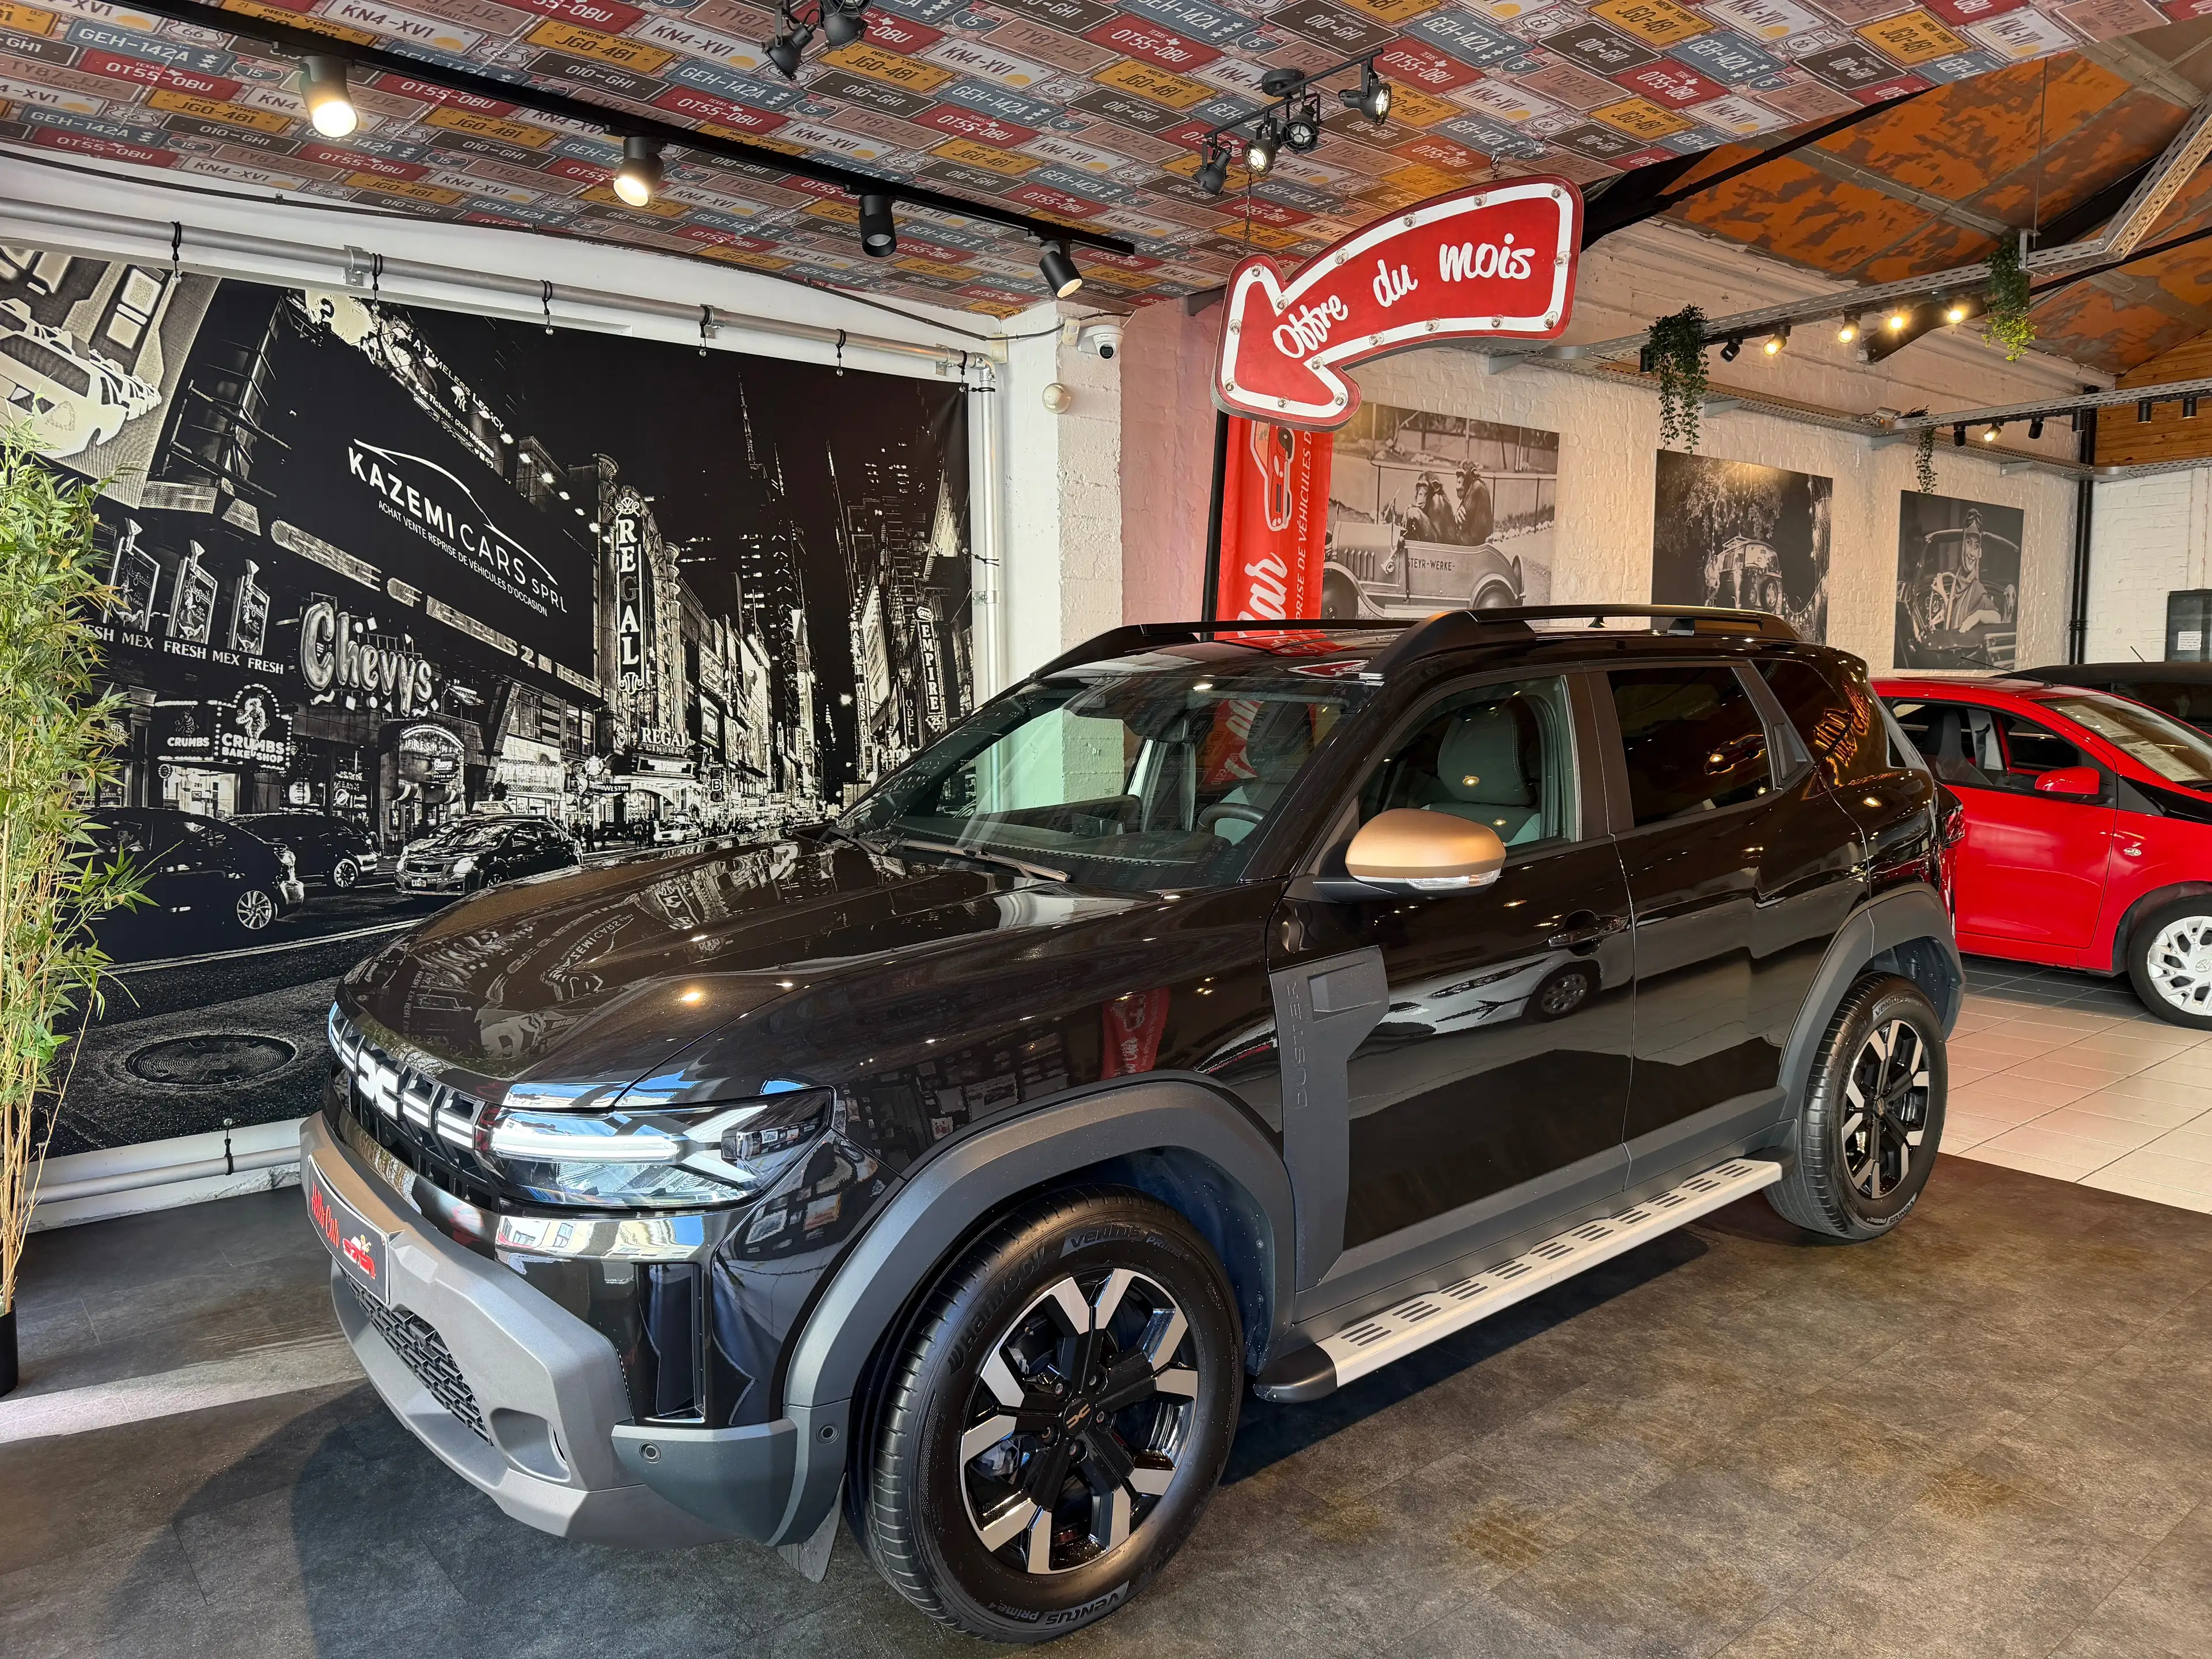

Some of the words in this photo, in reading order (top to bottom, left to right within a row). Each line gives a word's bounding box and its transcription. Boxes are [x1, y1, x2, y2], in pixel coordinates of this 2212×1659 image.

[963, 16, 981, 26] 15
[1530, 18, 1553, 28] 66
[183, 28, 204, 39] 66
[577, 29, 607, 40] NEW
[612, 38, 645, 52] YORK
[650, 25, 736, 56] KN4-XV1
[1147, 29, 1169, 39] TEXAS
[1244, 35, 1263, 48] 15
[1422, 16, 1497, 54] GEH-142A
[78, 28, 191, 62] GEH-142A
[870, 50, 897, 60] NEW
[900, 59, 929, 70] YORK
[940, 47, 1017, 75] KN4-XV1
[1509, 59, 1527, 70] 15
[245, 68, 263, 77] 15
[679, 66, 766, 100] GEH-142A
[1145, 69, 1168, 78] NEW
[1170, 77, 1195, 88] YORK
[951, 86, 1025, 116] GEH-142A
[1047, 86, 1065, 95] 66
[804, 103, 820, 114] 15
[31, 110, 128, 137] GEH-142A
[1059, 118, 1073, 127] 15
[181, 141, 195, 149] 15
[435, 155, 451, 164] 15
[1372, 258, 1419, 308] du
[1439, 233, 1535, 282] mois
[1297, 451, 1312, 543] VÉHICULES
[348, 446, 454, 540] KAZEMI
[459, 523, 527, 585] CARS
[531, 578, 568, 613] SPRL
[378, 500, 402, 522] ACHAT
[403, 515, 427, 539] VENTE
[427, 532, 457, 559] REPRISE
[457, 551, 468, 566] DE
[468, 558, 506, 594] VÉHICULES
[507, 582, 548, 618] D'OCCASION
[1297, 546, 1306, 571] DE
[618, 518, 640, 666] REGAL
[122, 632, 154, 650] MEX
[163, 641, 207, 660] FRESH
[212, 650, 240, 666] MEX
[247, 657, 284, 675] FRESH
[300, 601, 433, 718] Chevys
[921, 624, 939, 711] EMPIRE
[167, 737, 210, 748] CRUMBS
[221, 733, 285, 755] CRUMBS
[221, 747, 250, 759] BAKE
[256, 752, 283, 764] SHOP
